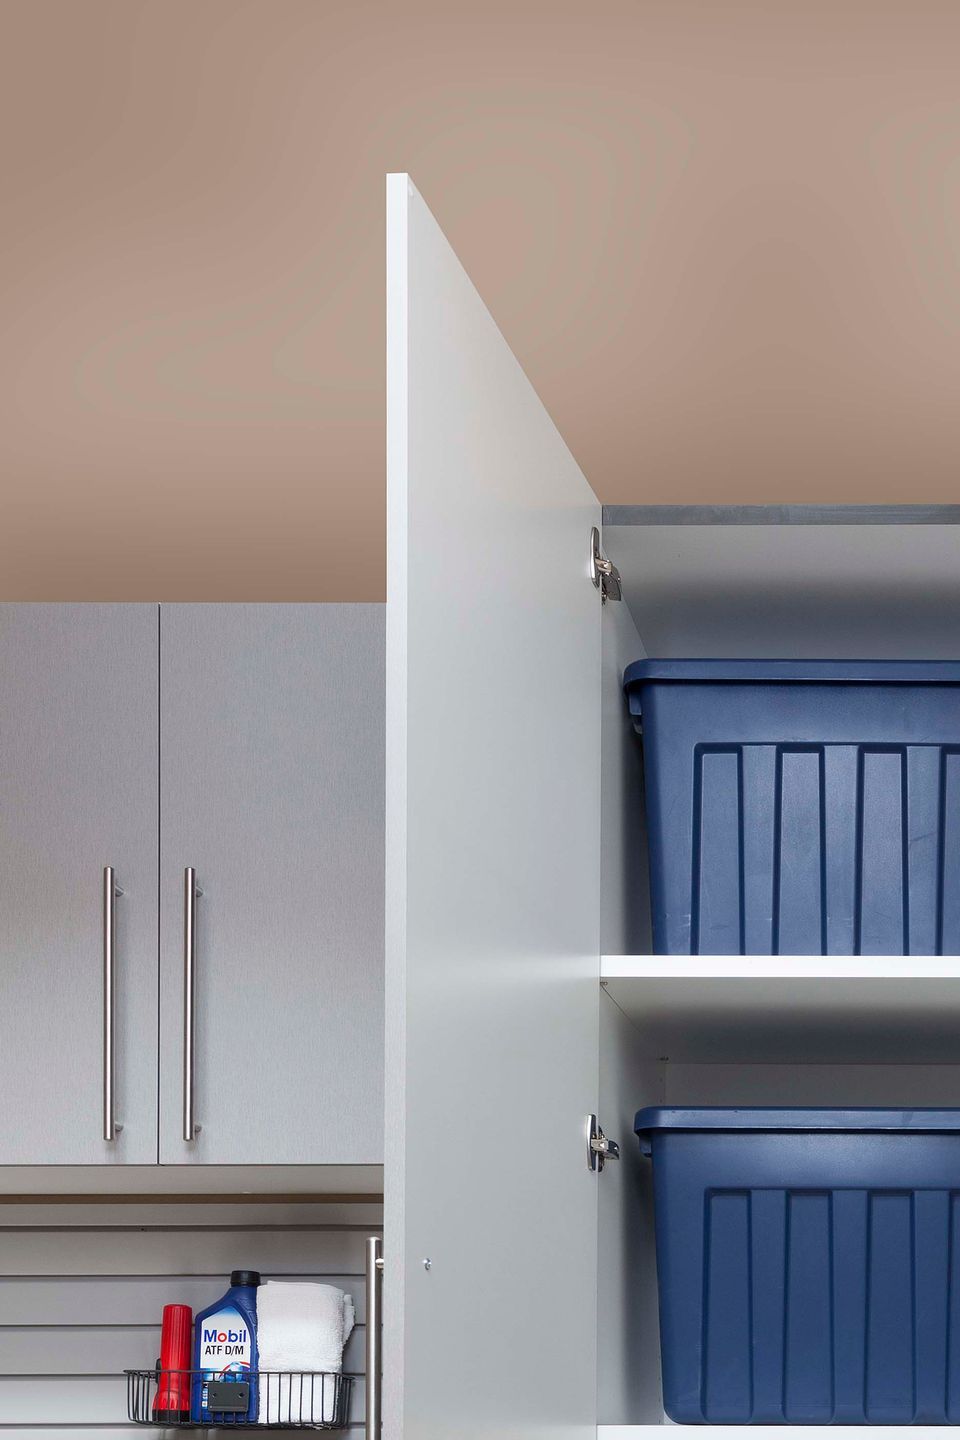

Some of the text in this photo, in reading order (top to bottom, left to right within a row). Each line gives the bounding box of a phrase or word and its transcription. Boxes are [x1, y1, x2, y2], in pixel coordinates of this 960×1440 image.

[203, 1329, 247, 1343] Mobil
[205, 1345, 244, 1356] ATF D/M
